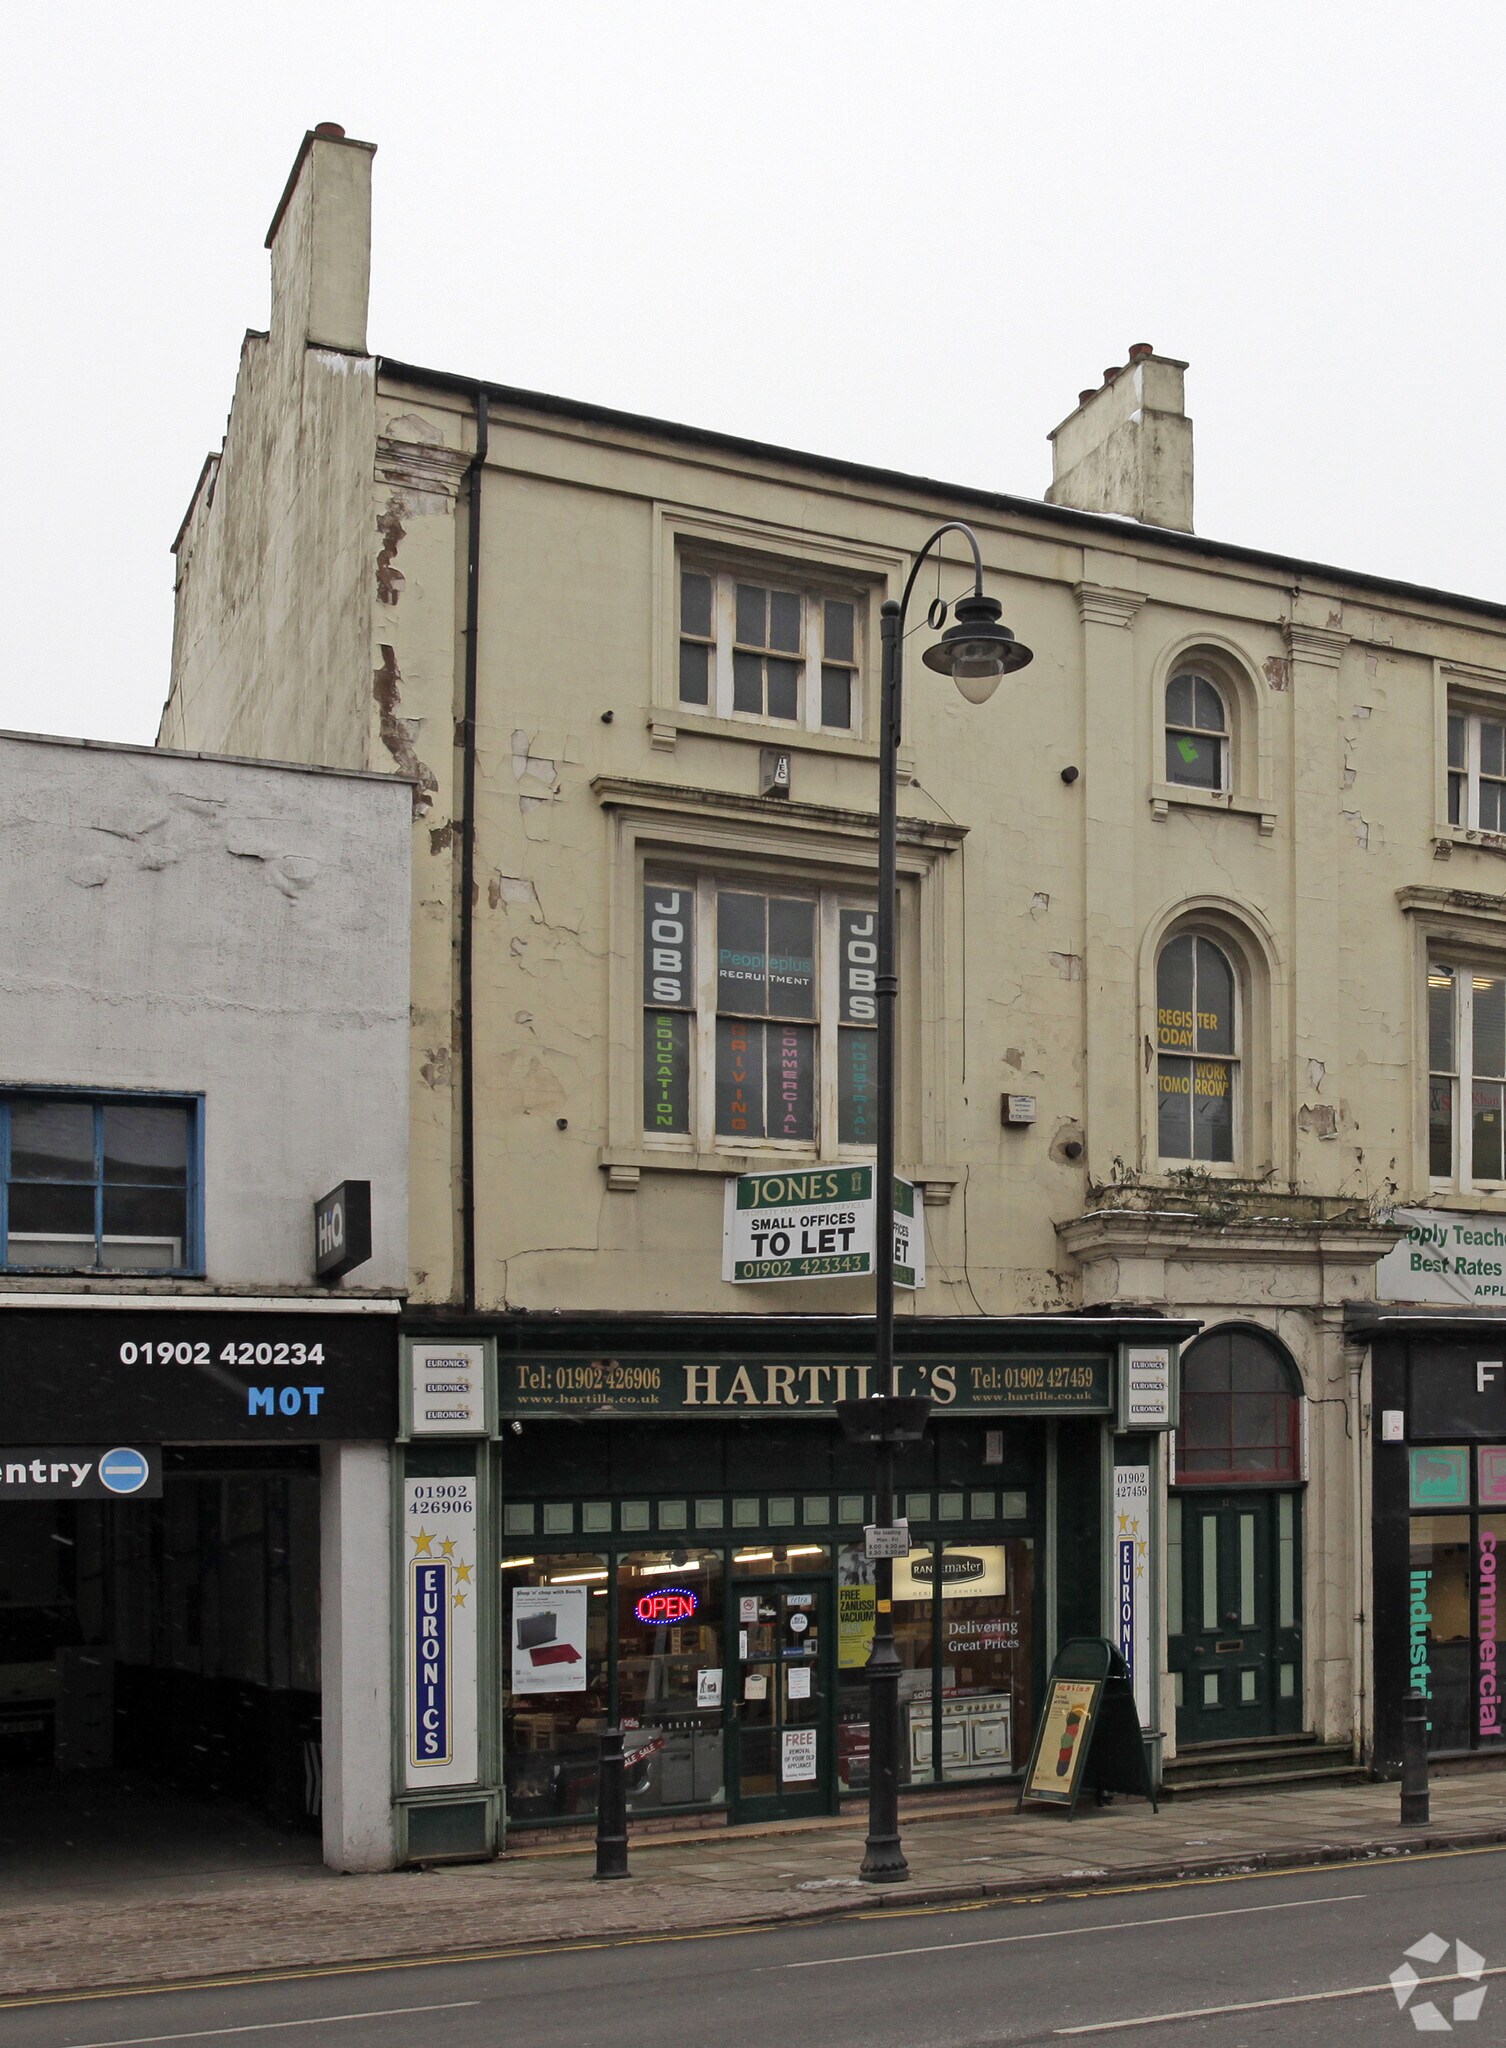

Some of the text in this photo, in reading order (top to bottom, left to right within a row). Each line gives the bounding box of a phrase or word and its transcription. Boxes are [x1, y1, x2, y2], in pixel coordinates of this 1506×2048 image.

[651, 892, 684, 1002] JOBS
[847, 914, 877, 1019] JOBS
[719, 969, 809, 986] RECRUITMENT
[1158, 1008, 1218, 1030] REGISTER
[656, 1015, 673, 1126] EDUCATION
[731, 1024, 747, 1130] DRIVING
[781, 1027, 798, 1134] COMMERCIAL
[1196, 1062, 1227, 1081] WORK
[750, 1173, 839, 1208] JONES
[780, 1204, 831, 1215] MANAGEMENT
[751, 1212, 856, 1231] SMALL OFFICES
[750, 1227, 856, 1258] TO LET
[894, 1237, 909, 1263] ET
[743, 1255, 862, 1278] 01902 423343
[1410, 1252, 1503, 1276] Best Rates
[119, 1341, 326, 1366] 01902 420234
[426, 1360, 468, 1368] EURONICS
[1132, 1361, 1163, 1369] EURONICS
[517, 1365, 660, 1389] Tel: 01902 426906
[971, 1366, 1093, 1389] Tel: 01902 427459
[1132, 1382, 1163, 1390] EURONICS
[1476, 1361, 1503, 1392] F
[426, 1384, 468, 1392] EURONICS
[972, 1391, 1092, 1402] www.hartills.co.uk
[247, 1386, 326, 1416] MOT
[517, 1393, 660, 1404] www.hartills.co.uk
[426, 1411, 468, 1419] EURONICS
[1132, 1405, 1163, 1413] EURONICS
[0, 1459, 93, 1488] ntry
[1117, 1472, 1145, 1483] 01902
[414, 1485, 468, 1499] 01902
[1115, 1485, 1148, 1498] 427459
[409, 1501, 473, 1515] 426906
[840, 1589, 861, 1601] FREE
[637, 1597, 695, 1619] OPEN
[840, 1599, 874, 1612] ZANUSSI
[1122, 1545, 1131, 1679] EURONI
[948, 1620, 1019, 1635] Delivering
[1479, 1531, 1502, 1736] commercial
[948, 1638, 1020, 1652] Great Prices
[422, 1569, 440, 1755] EURONICS
[913, 1689, 932, 1700] sale
[785, 1732, 813, 1747] FREE
[624, 1743, 656, 1768] ALE SALE
